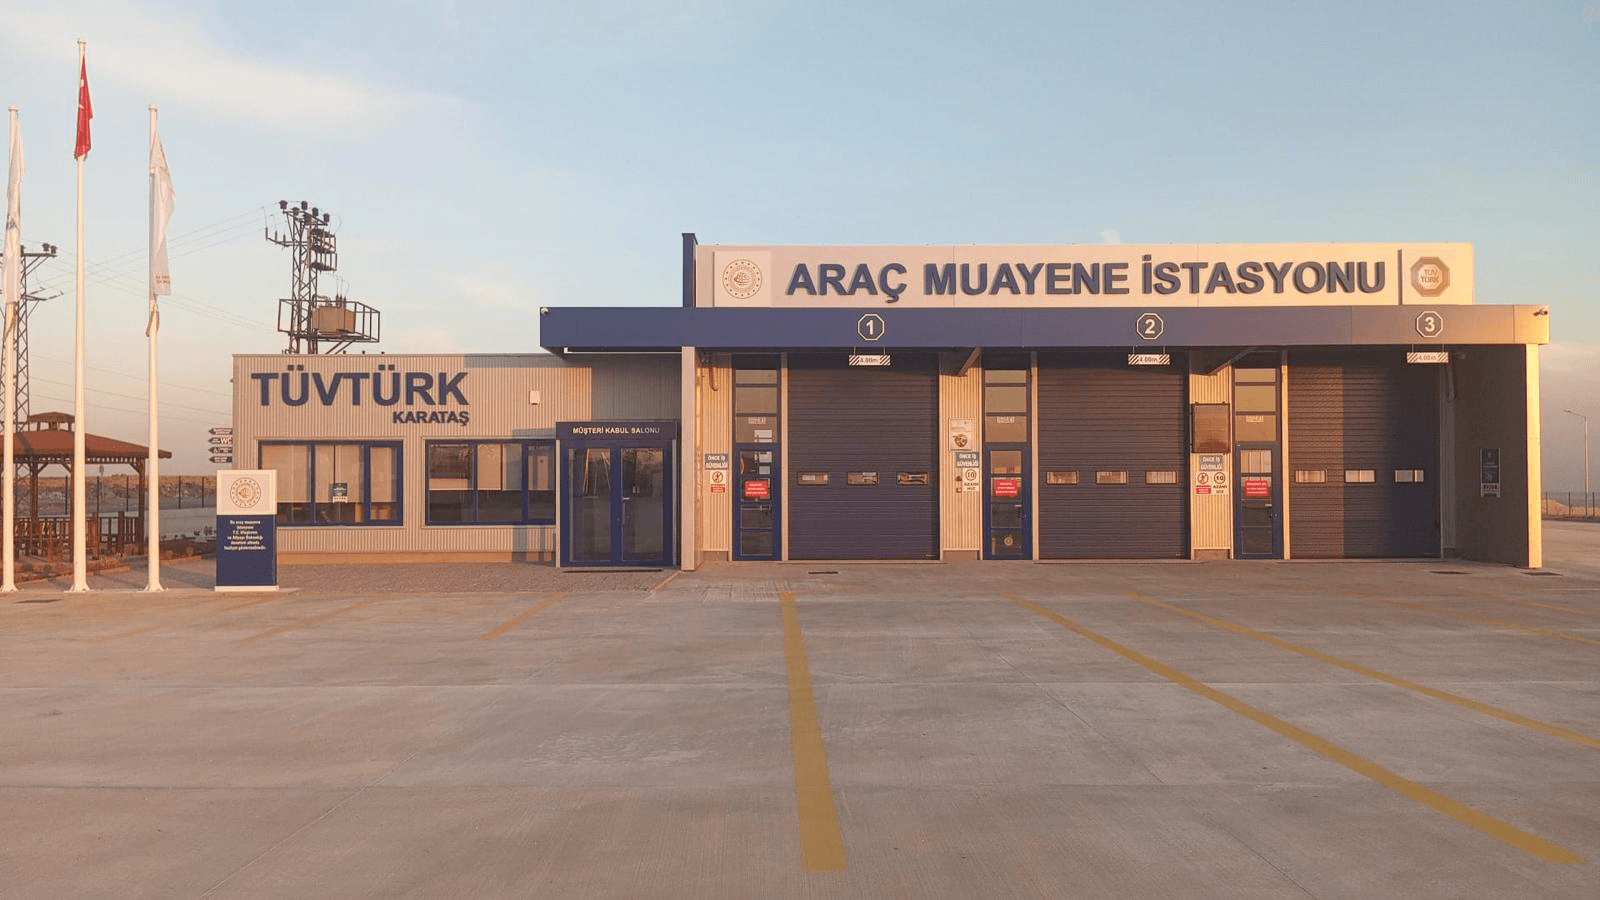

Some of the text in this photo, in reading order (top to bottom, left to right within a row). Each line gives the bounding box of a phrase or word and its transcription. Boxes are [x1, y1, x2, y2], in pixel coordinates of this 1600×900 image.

[786, 262, 908, 304] ARAÇ
[923, 262, 1130, 296] MUAYENE
[1141, 254, 1386, 295] İSTASYONU
[866, 319, 874, 336] 1
[1144, 318, 1156, 335] 2
[1424, 316, 1436, 333] 3
[250, 364, 470, 406] TÜVTÜRK
[392, 411, 470, 426] KARATAŞ
[572, 426, 604, 435] MÜŞTERİ
